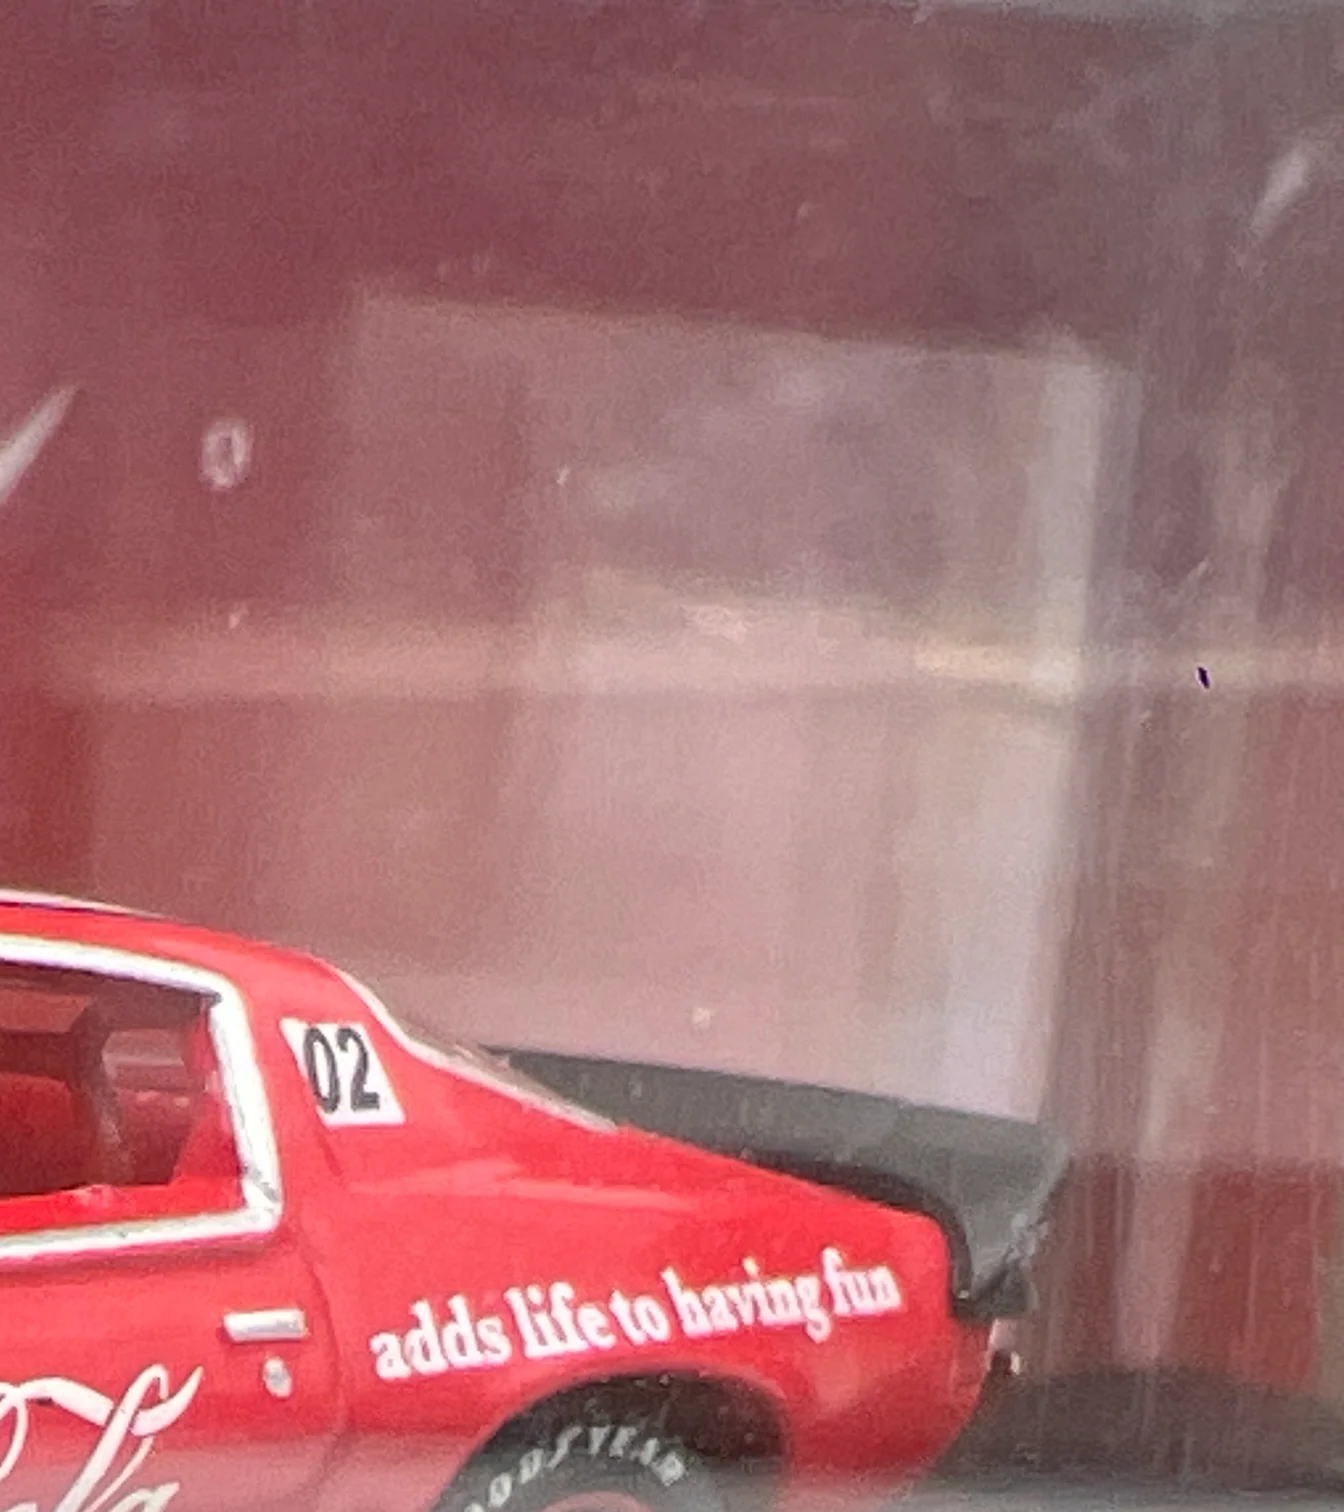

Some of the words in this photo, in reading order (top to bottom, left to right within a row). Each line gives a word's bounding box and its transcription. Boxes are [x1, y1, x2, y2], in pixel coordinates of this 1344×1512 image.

[303, 1027, 380, 1112] 02
[368, 1294, 512, 1381] adds
[503, 1281, 617, 1359] life
[609, 1288, 671, 1345] to
[660, 1265, 832, 1344] having
[821, 1246, 902, 1317] fun
